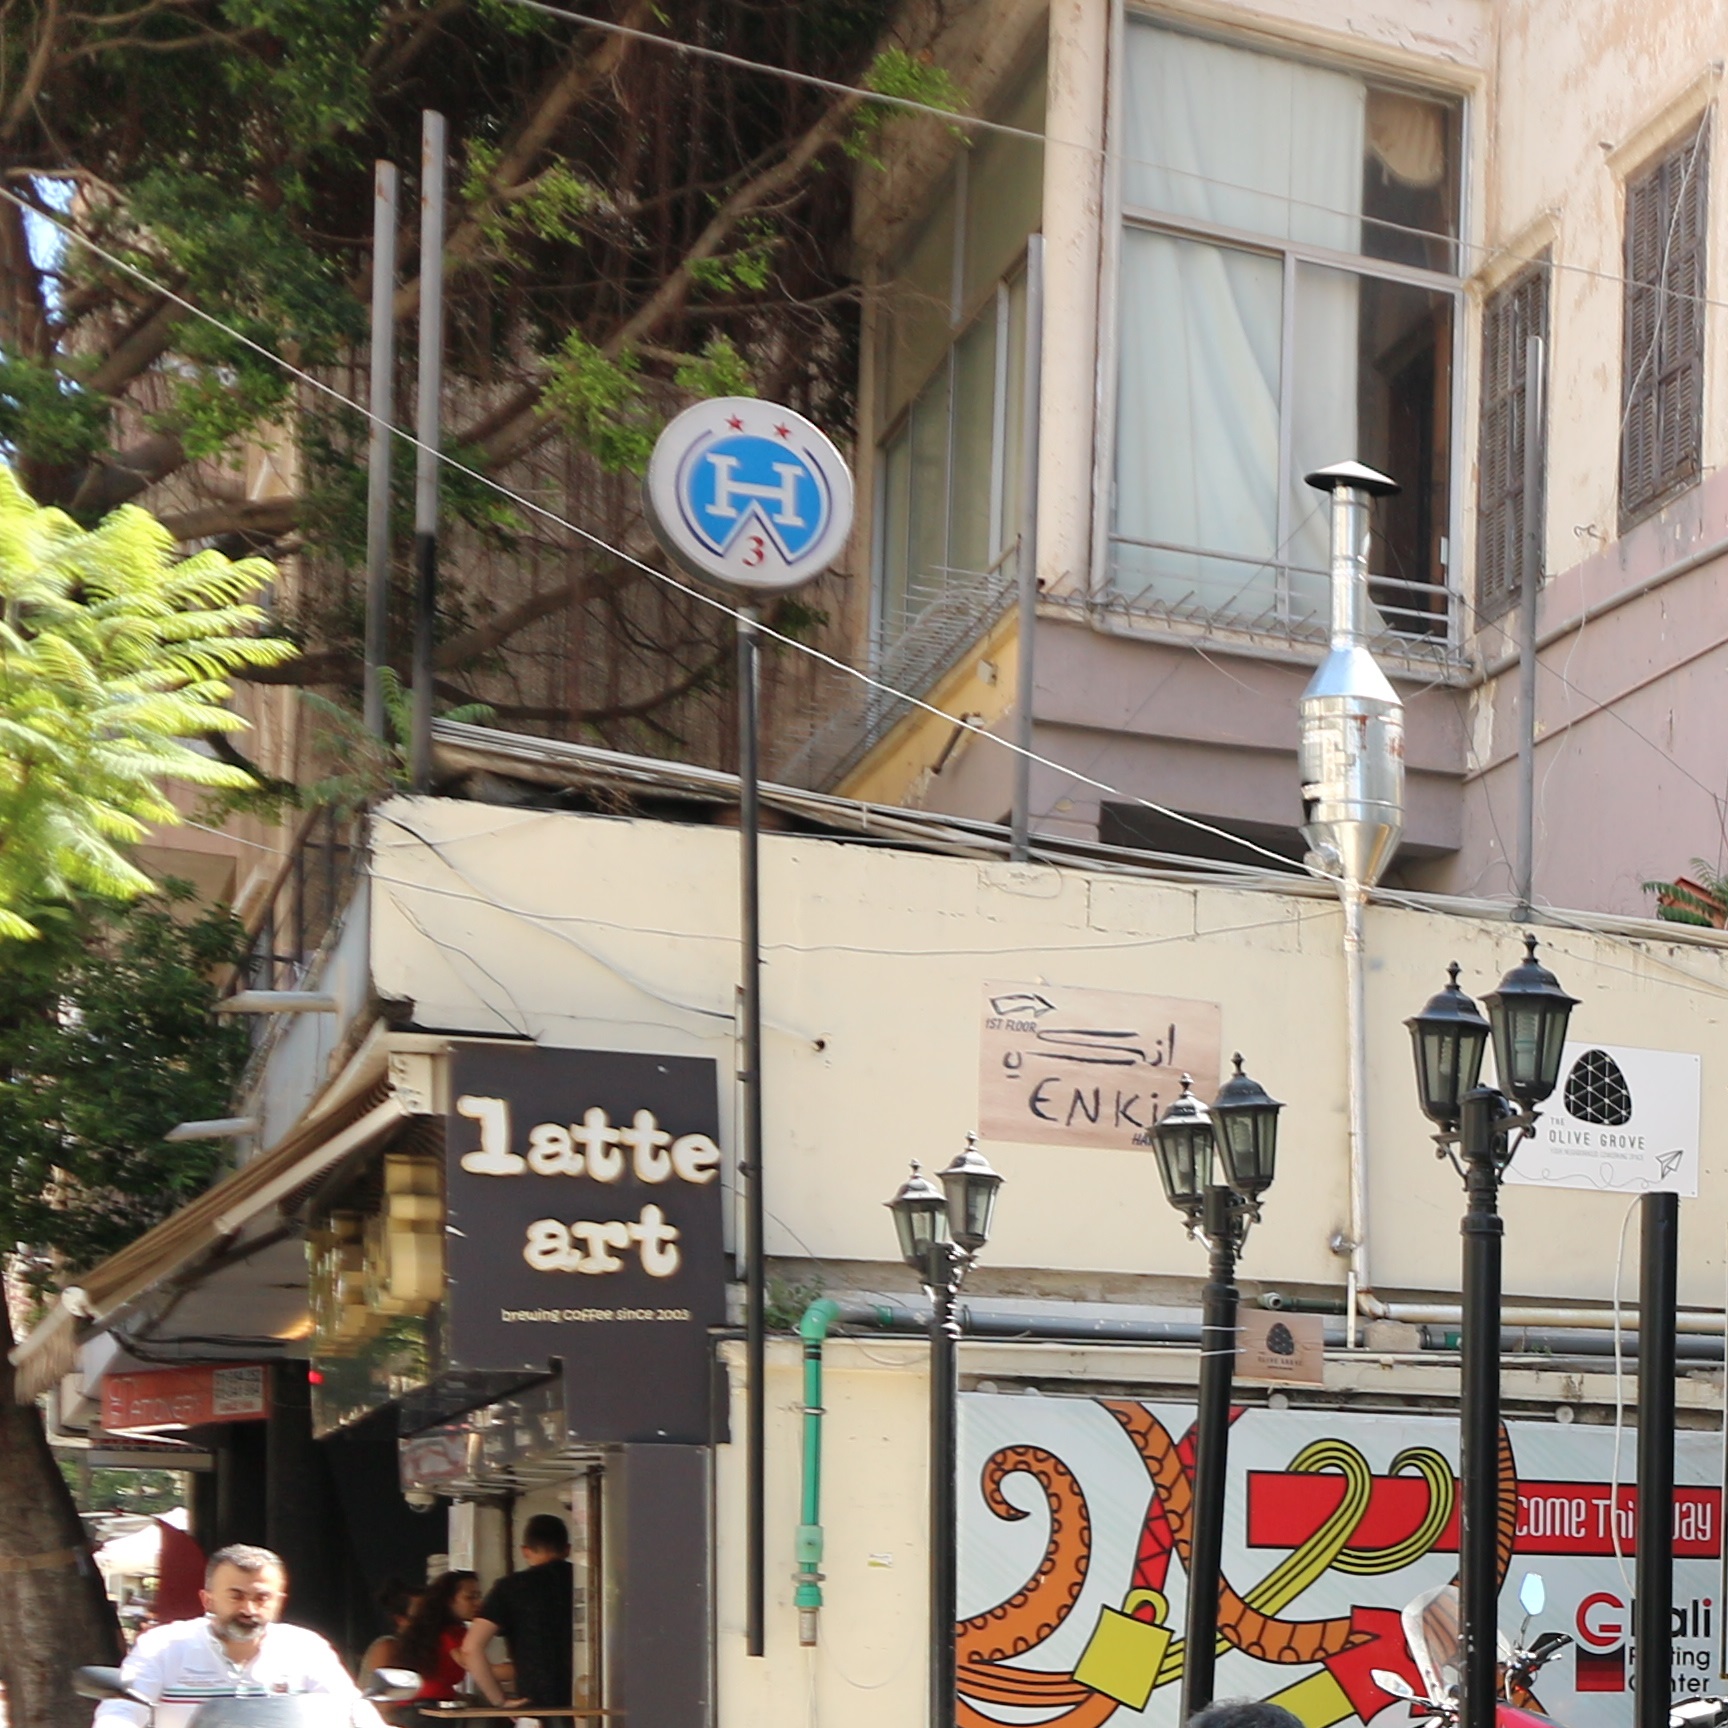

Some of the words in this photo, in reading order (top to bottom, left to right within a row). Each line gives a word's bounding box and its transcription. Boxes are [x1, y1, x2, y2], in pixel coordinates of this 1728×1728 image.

[742, 536, 764, 567] 3
[1005, 1020, 1037, 1033] FLOOR
[457, 1095, 720, 1184] latte
[1549, 1130, 1590, 1146] OLIVE
[1600, 1134, 1645, 1150] GROVE
[523, 1203, 680, 1277] art
[501, 1308, 561, 1324] brewing
[563, 1308, 614, 1321] coffee
[616, 1308, 654, 1321] since
[656, 1309, 690, 1322] 2003
